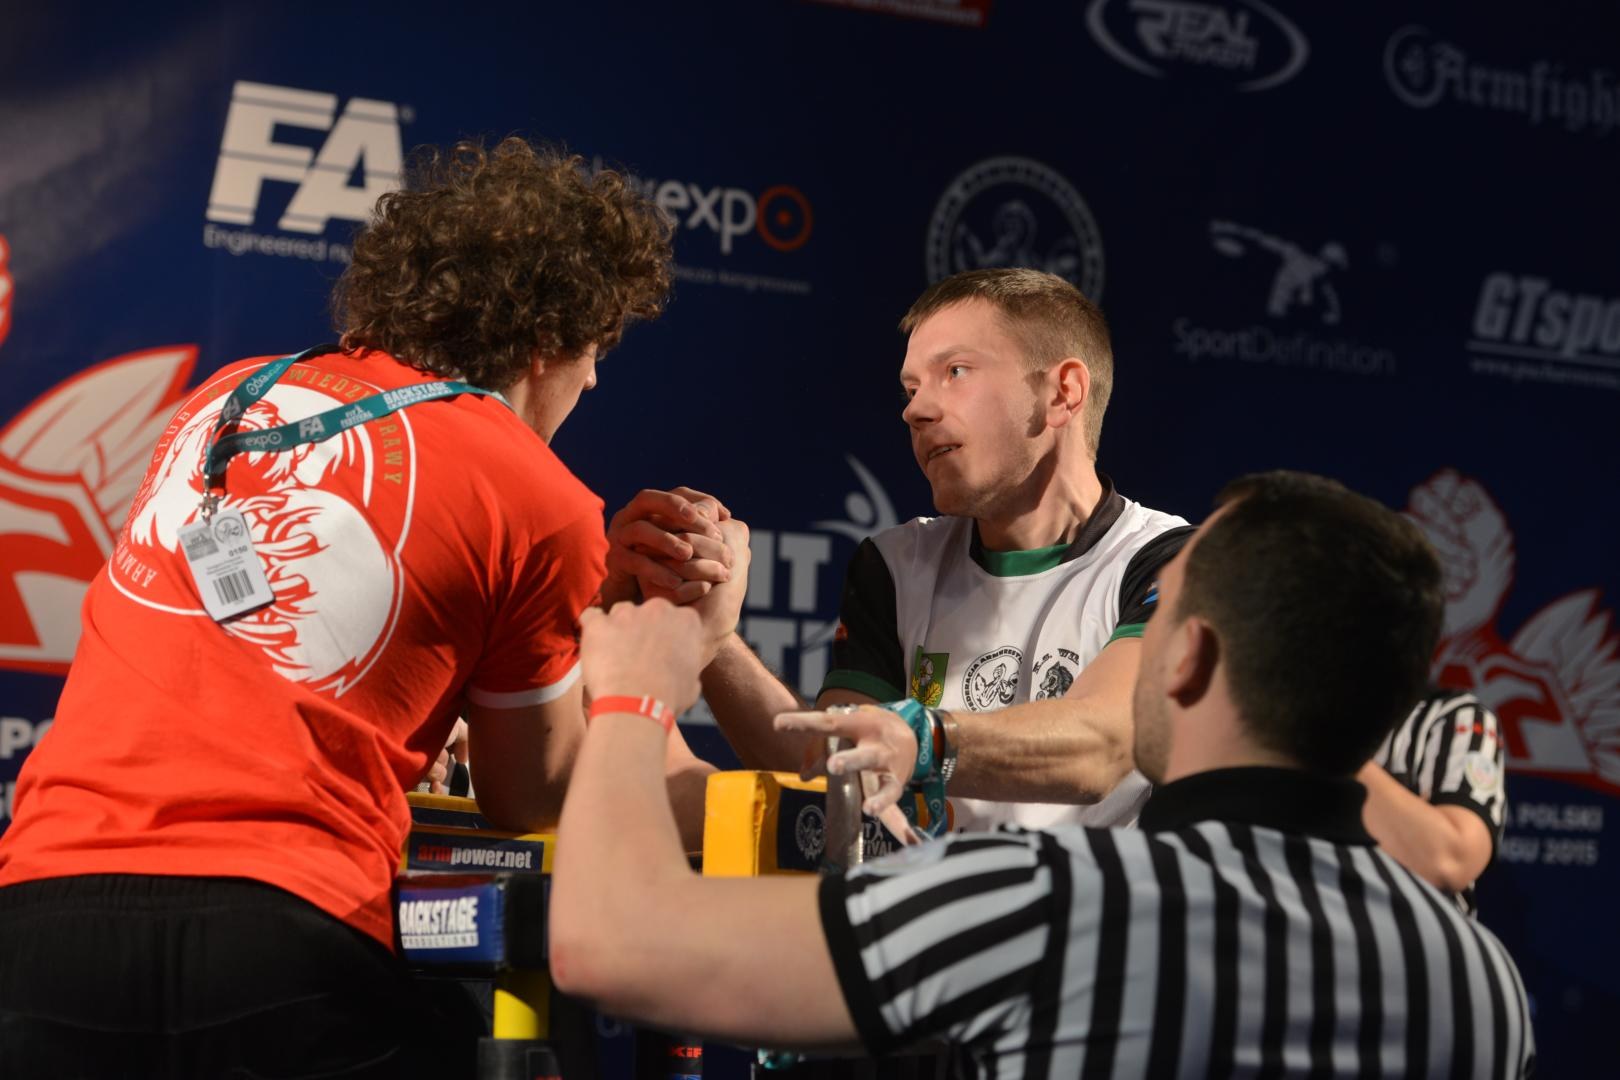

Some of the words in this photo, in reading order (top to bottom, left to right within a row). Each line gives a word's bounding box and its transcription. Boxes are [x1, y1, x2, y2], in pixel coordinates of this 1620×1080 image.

[1430, 41, 1620, 136] Armfigh
[206, 80, 405, 234] FA
[204, 223, 327, 260] Engineered
[299, 414, 326, 441] FA
[747, 529, 834, 615] IT
[1516, 803, 1604, 833] POLSKI
[418, 845, 533, 870] armpower.net
[1542, 839, 1600, 867] 2015
[399, 896, 479, 936] BACKSTAGE
